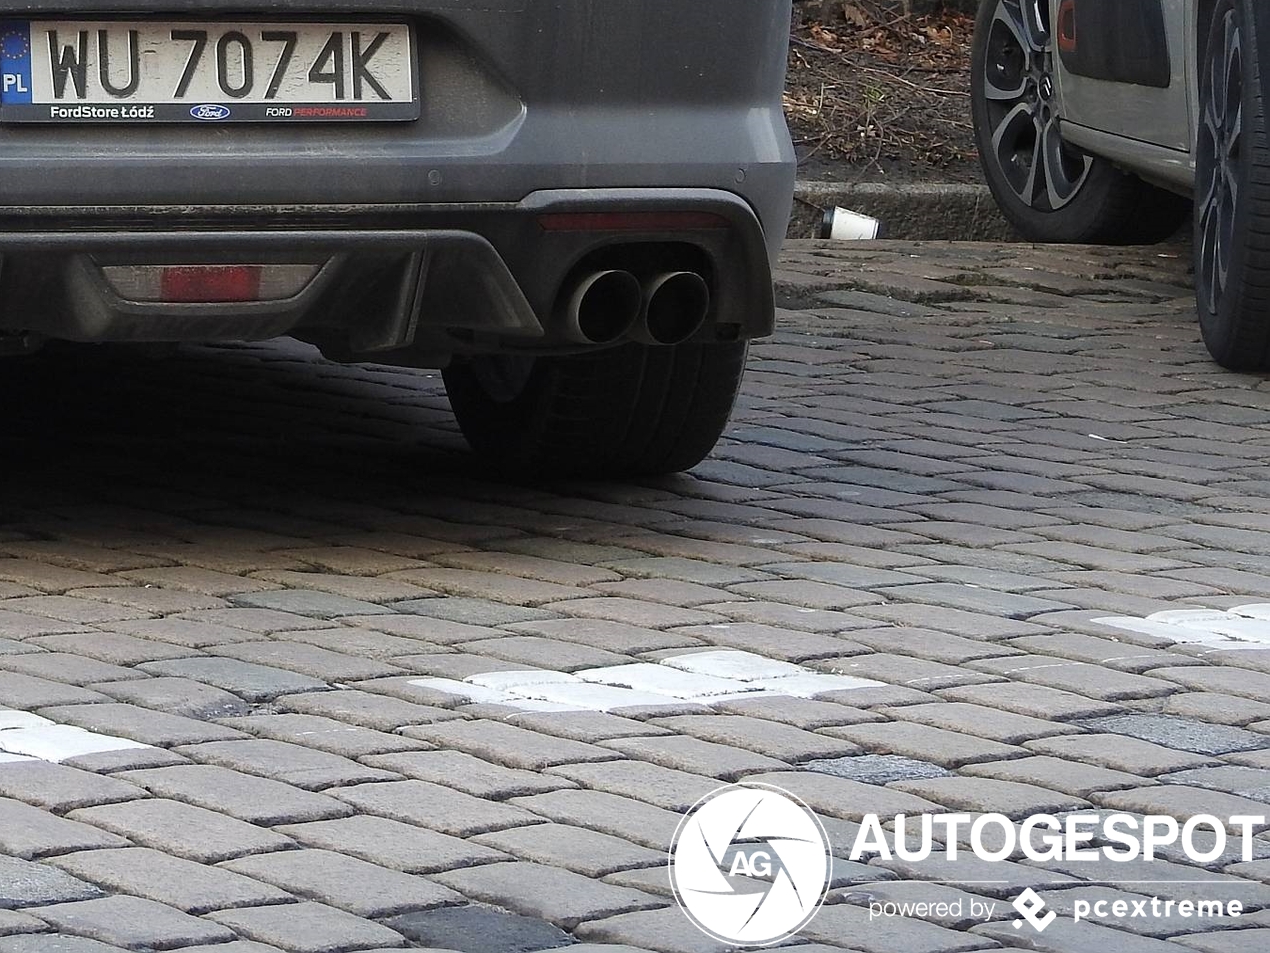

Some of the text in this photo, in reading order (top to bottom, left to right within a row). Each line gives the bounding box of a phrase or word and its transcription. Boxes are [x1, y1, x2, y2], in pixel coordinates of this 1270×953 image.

[46, 29, 393, 100] WU 7074K
[3, 74, 28, 93] PL
[50, 104, 154, 119] FordStore Łódź
[196, 105, 223, 118] Ford
[265, 107, 367, 117] FORD PERFORMANCE
